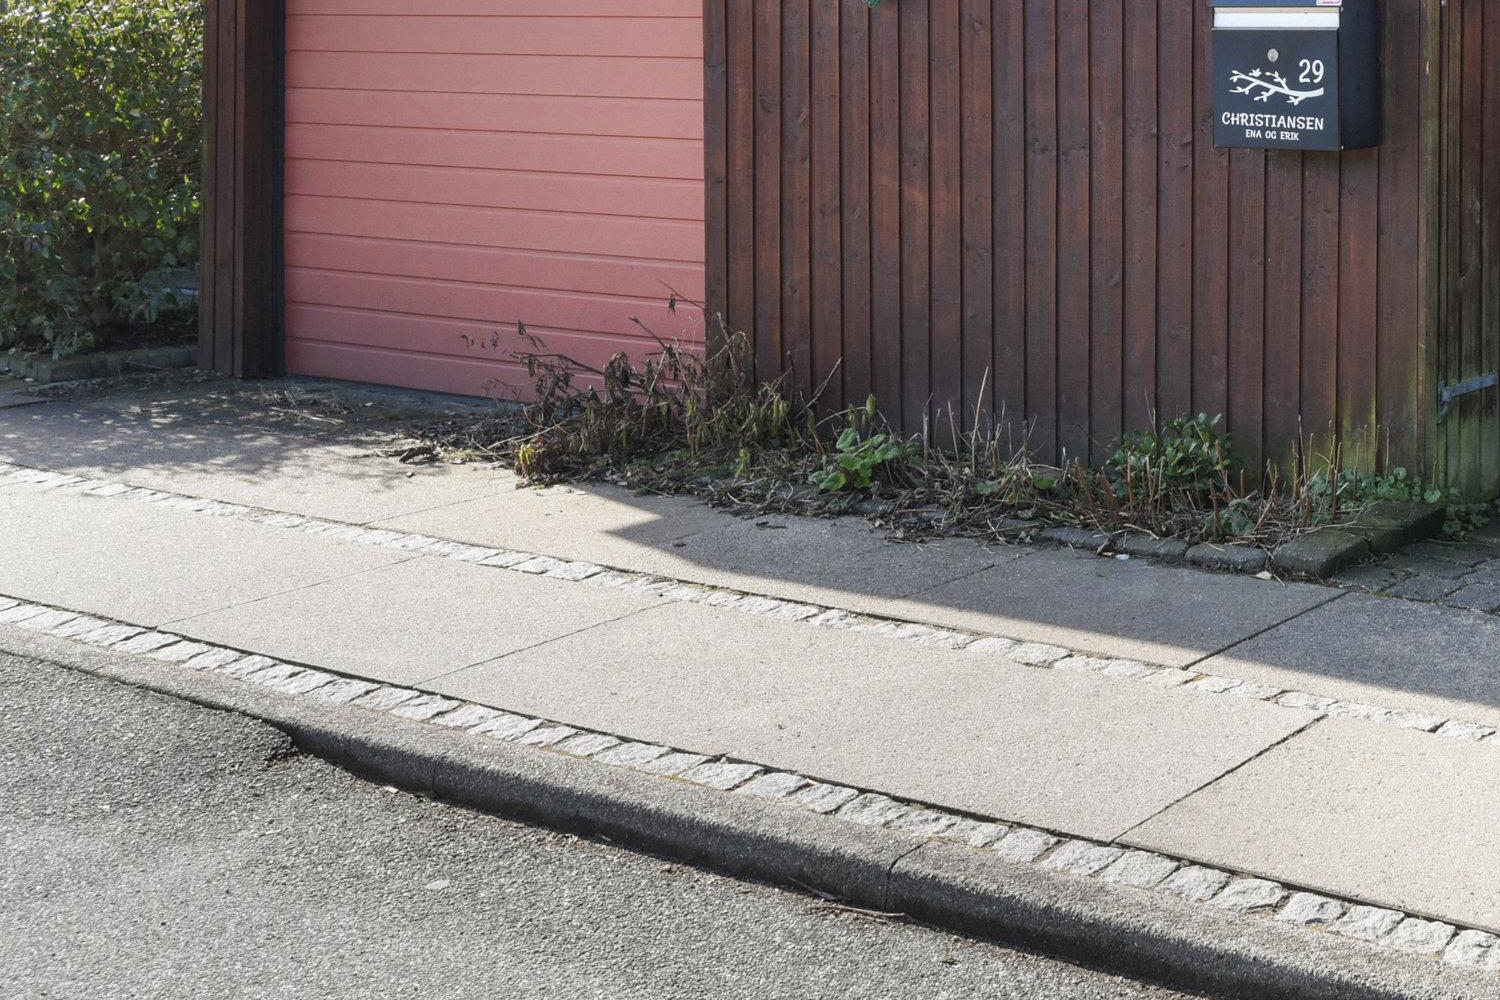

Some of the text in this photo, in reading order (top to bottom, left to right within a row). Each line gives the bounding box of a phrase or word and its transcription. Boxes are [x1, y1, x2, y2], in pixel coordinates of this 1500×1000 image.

[1298, 59, 1324, 83] 29
[1221, 111, 1324, 130] CHRISTIANSEN
[1245, 129, 1262, 138] ENA
[1280, 131, 1299, 141] ERIK
